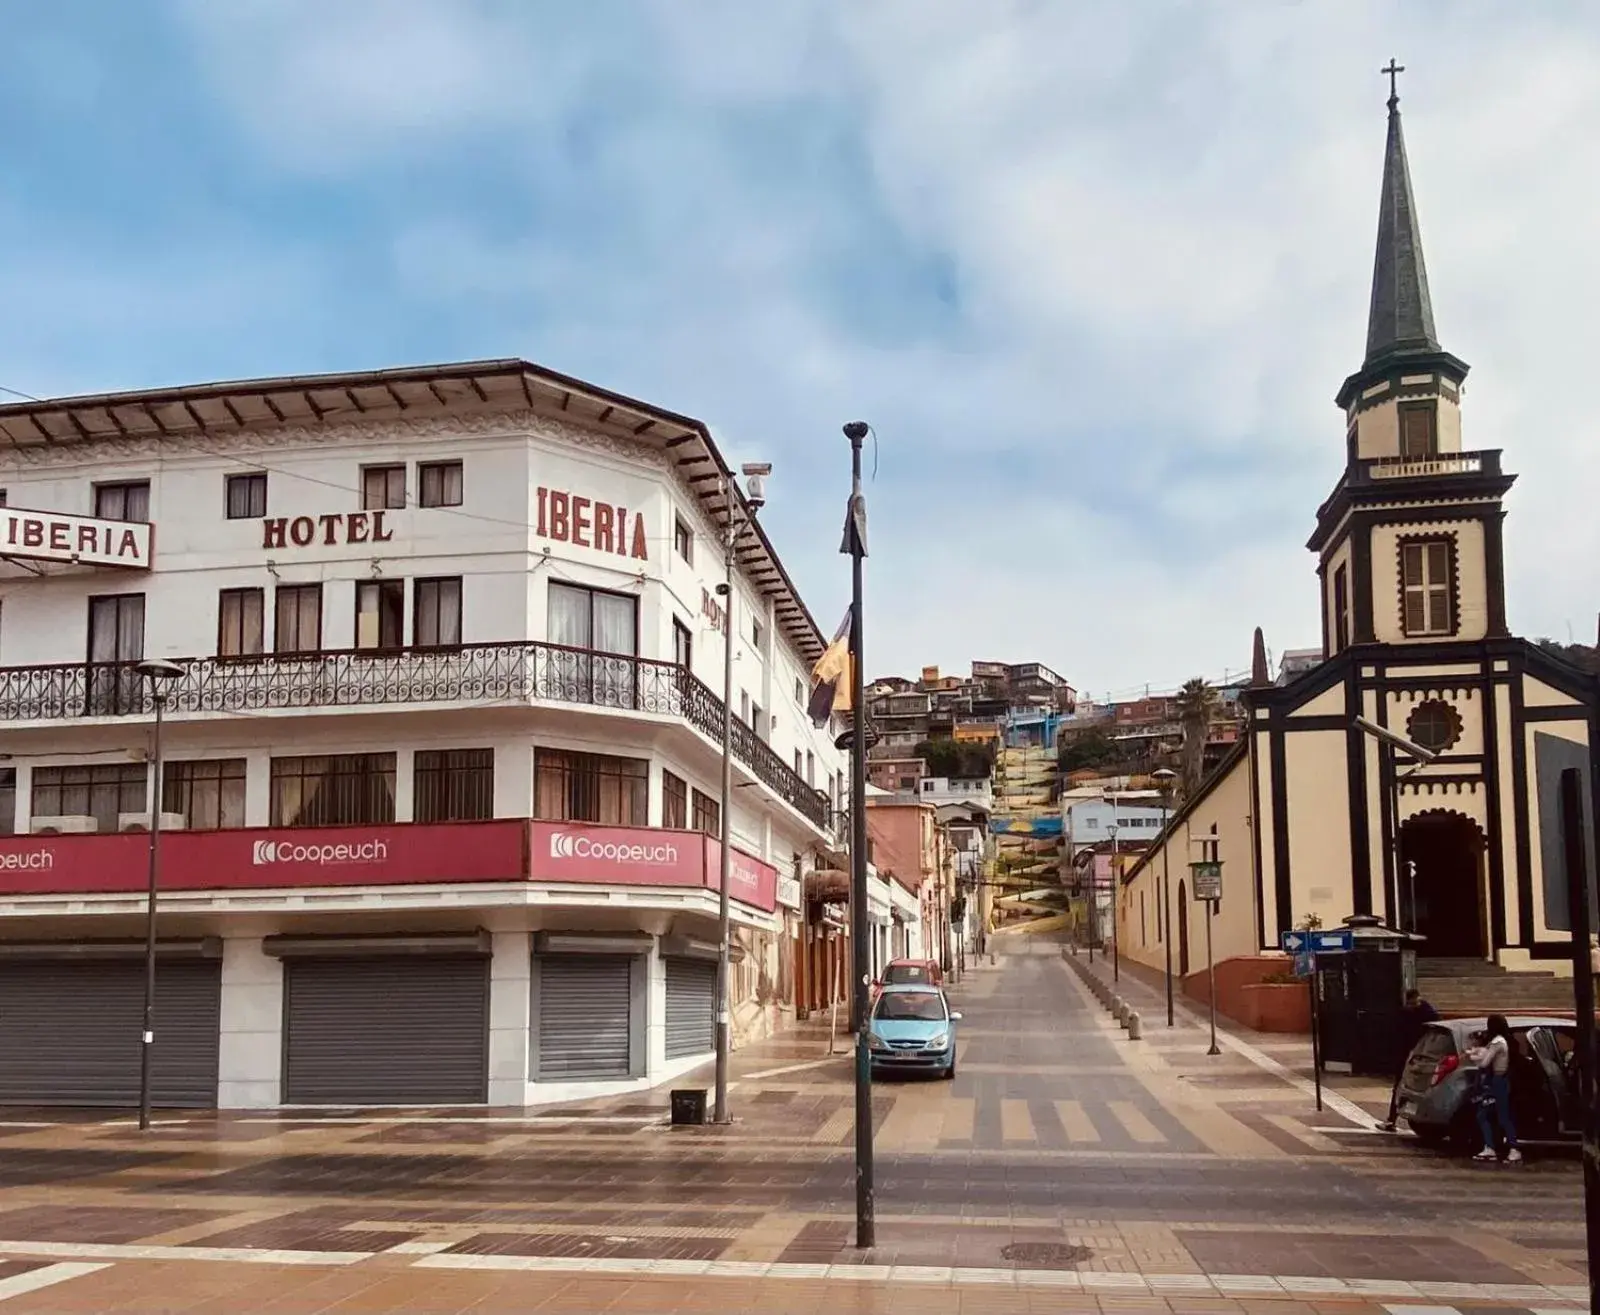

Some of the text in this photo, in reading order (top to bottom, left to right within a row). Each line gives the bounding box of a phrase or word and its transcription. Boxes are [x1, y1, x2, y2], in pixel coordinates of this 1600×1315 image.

[8, 517, 139, 559] IBERIA
[262, 510, 394, 549] HOTEL
[536, 486, 649, 561] IBERIA
[277, 839, 387, 866] Coopeuch
[574, 837, 677, 864] Coopeuch
